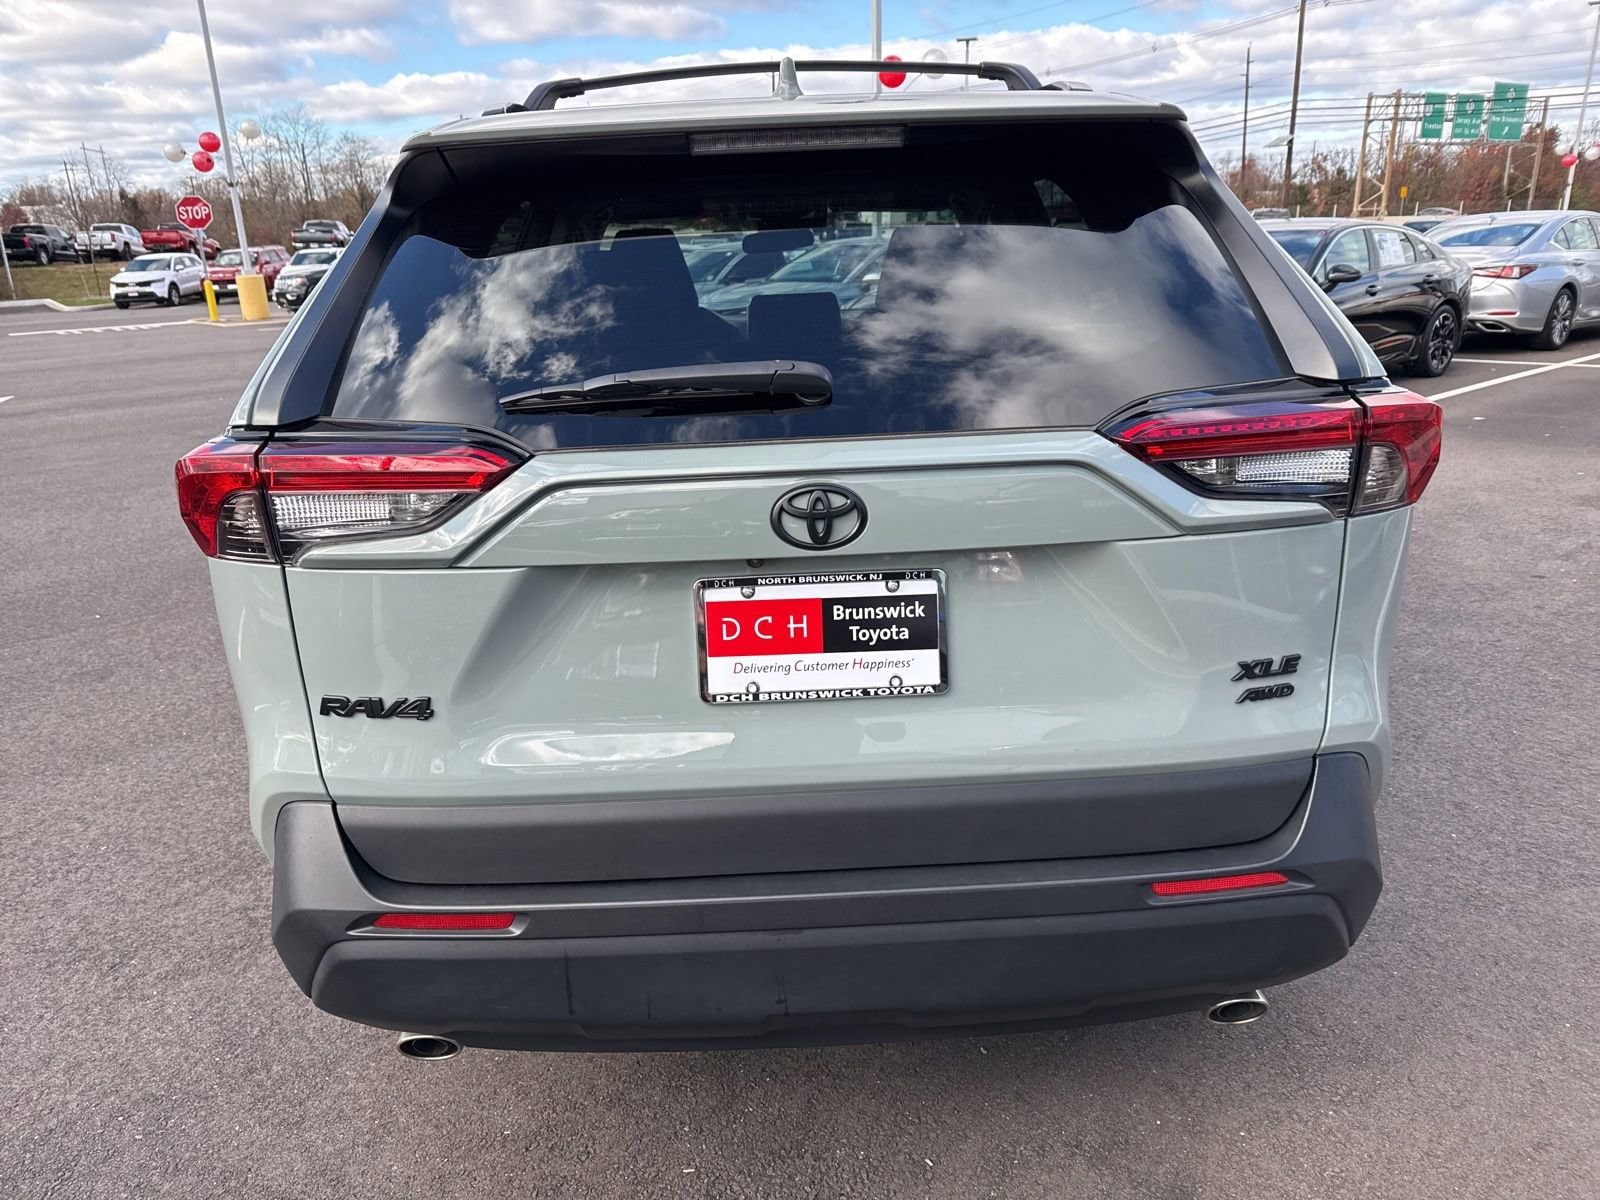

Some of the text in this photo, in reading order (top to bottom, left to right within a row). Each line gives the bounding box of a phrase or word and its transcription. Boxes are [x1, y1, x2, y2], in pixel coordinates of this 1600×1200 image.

[179, 206, 209, 219] STOP
[757, 577, 796, 585] NORTH
[832, 601, 926, 620] Brunswick
[849, 624, 910, 645] Toyota
[733, 662, 791, 675] Delivering
[794, 659, 849, 672] Customer
[1230, 653, 1302, 681] XLE
[716, 686, 935, 702] DCH BRUNSWICK TOYOTA
[1235, 682, 1295, 704] AWD
[320, 694, 434, 720] RAV4
